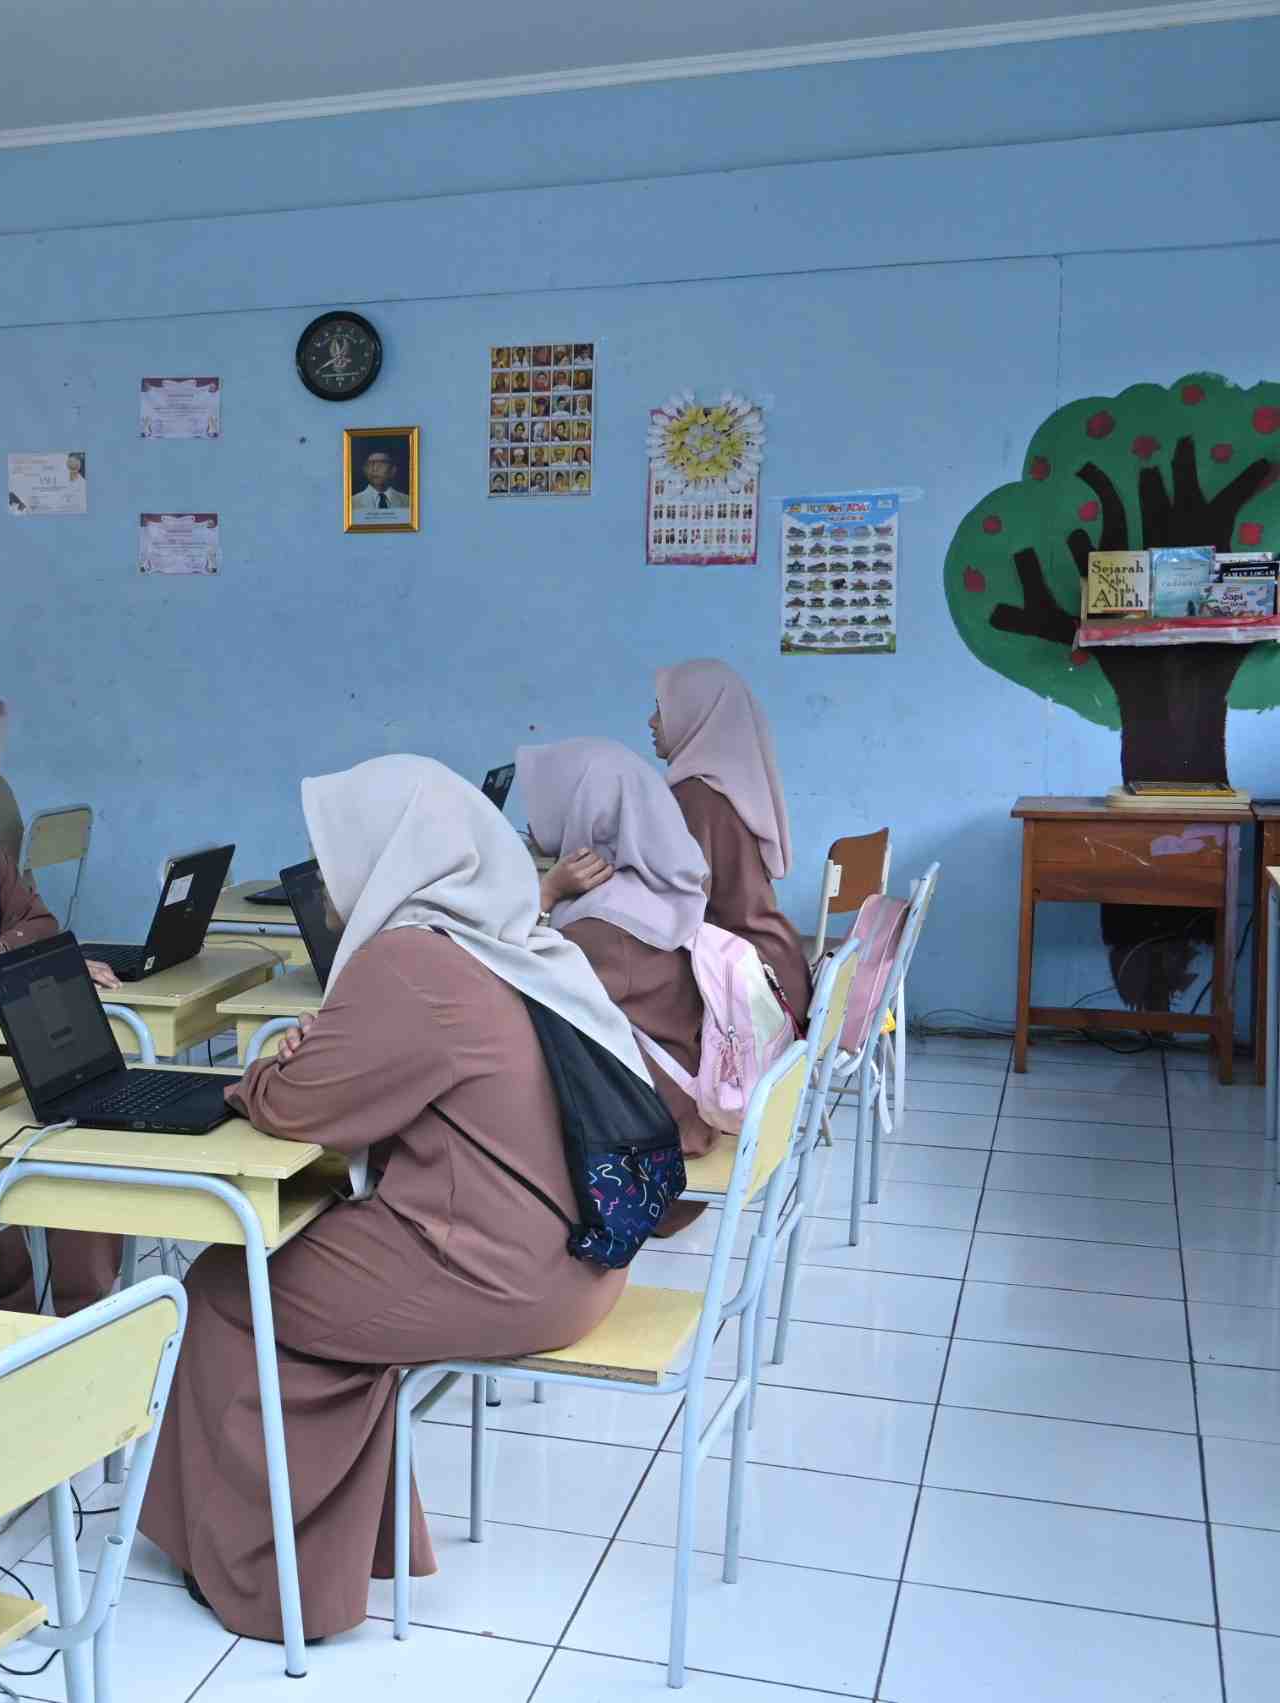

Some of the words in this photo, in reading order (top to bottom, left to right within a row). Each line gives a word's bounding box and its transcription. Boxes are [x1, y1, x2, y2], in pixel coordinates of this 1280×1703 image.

[1091, 560, 1144, 576] Sejarah
[1098, 574, 1125, 585] Nabi
[1092, 590, 1144, 608] Allah
